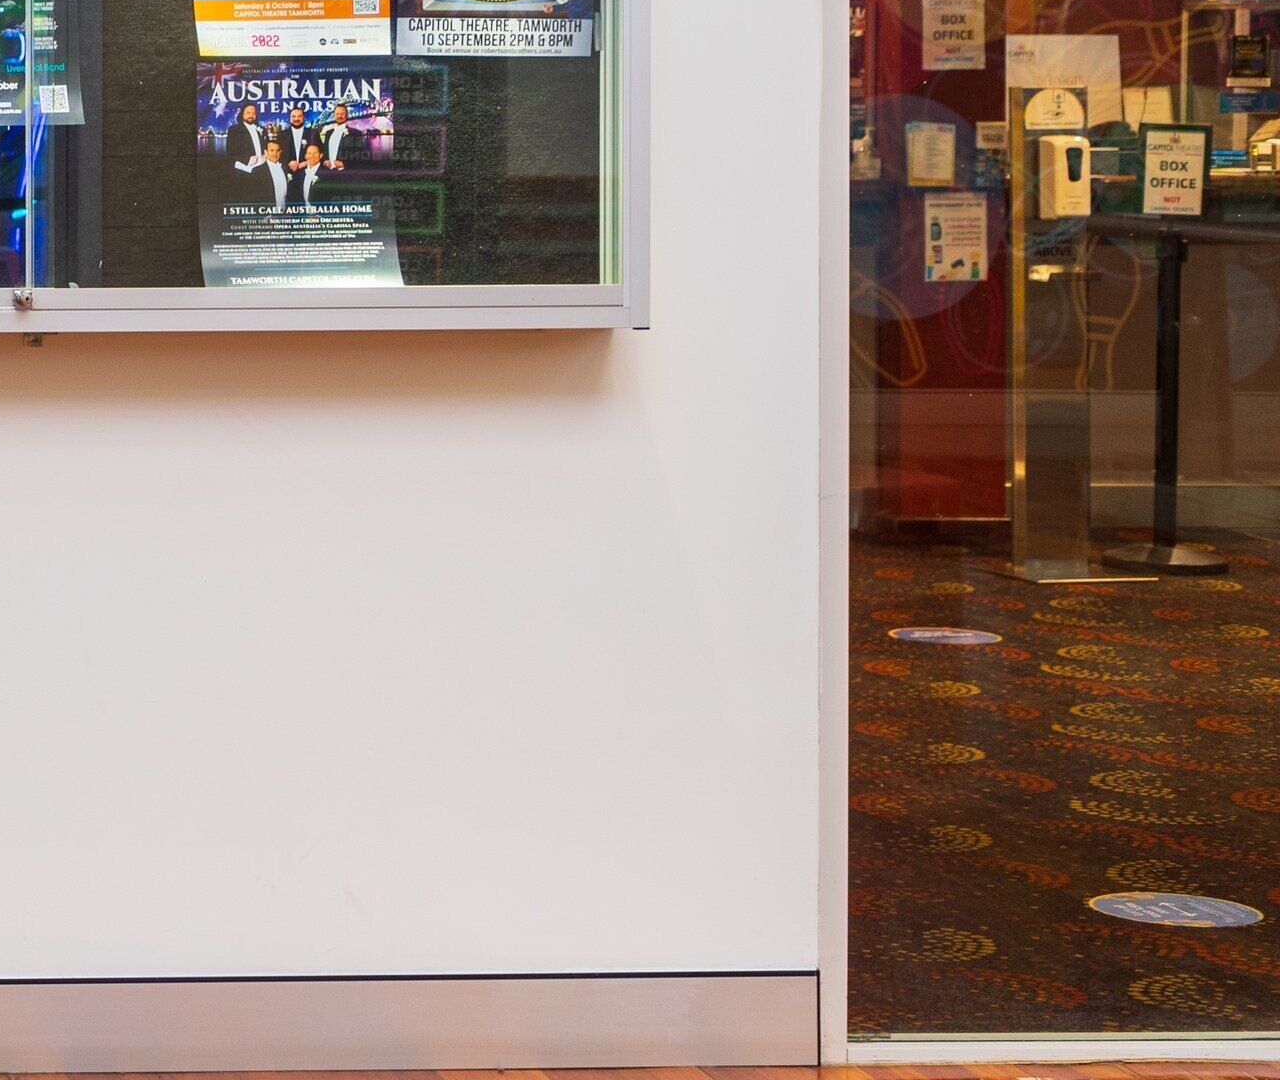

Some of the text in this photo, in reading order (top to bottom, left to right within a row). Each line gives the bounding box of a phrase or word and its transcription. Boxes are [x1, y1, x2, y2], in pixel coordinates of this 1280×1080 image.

[408, 18, 582, 33] CAPITOL THEATRE, TAMWORTH
[940, 14, 966, 25] BOX
[421, 33, 573, 47] 10 SEPTEMBER 2PM & 8PM
[933, 29, 975, 41] OFFICE
[209, 78, 382, 105] AUSTRALIAN
[1159, 160, 1189, 172] BOX
[1150, 177, 1197, 190] OFFICE
